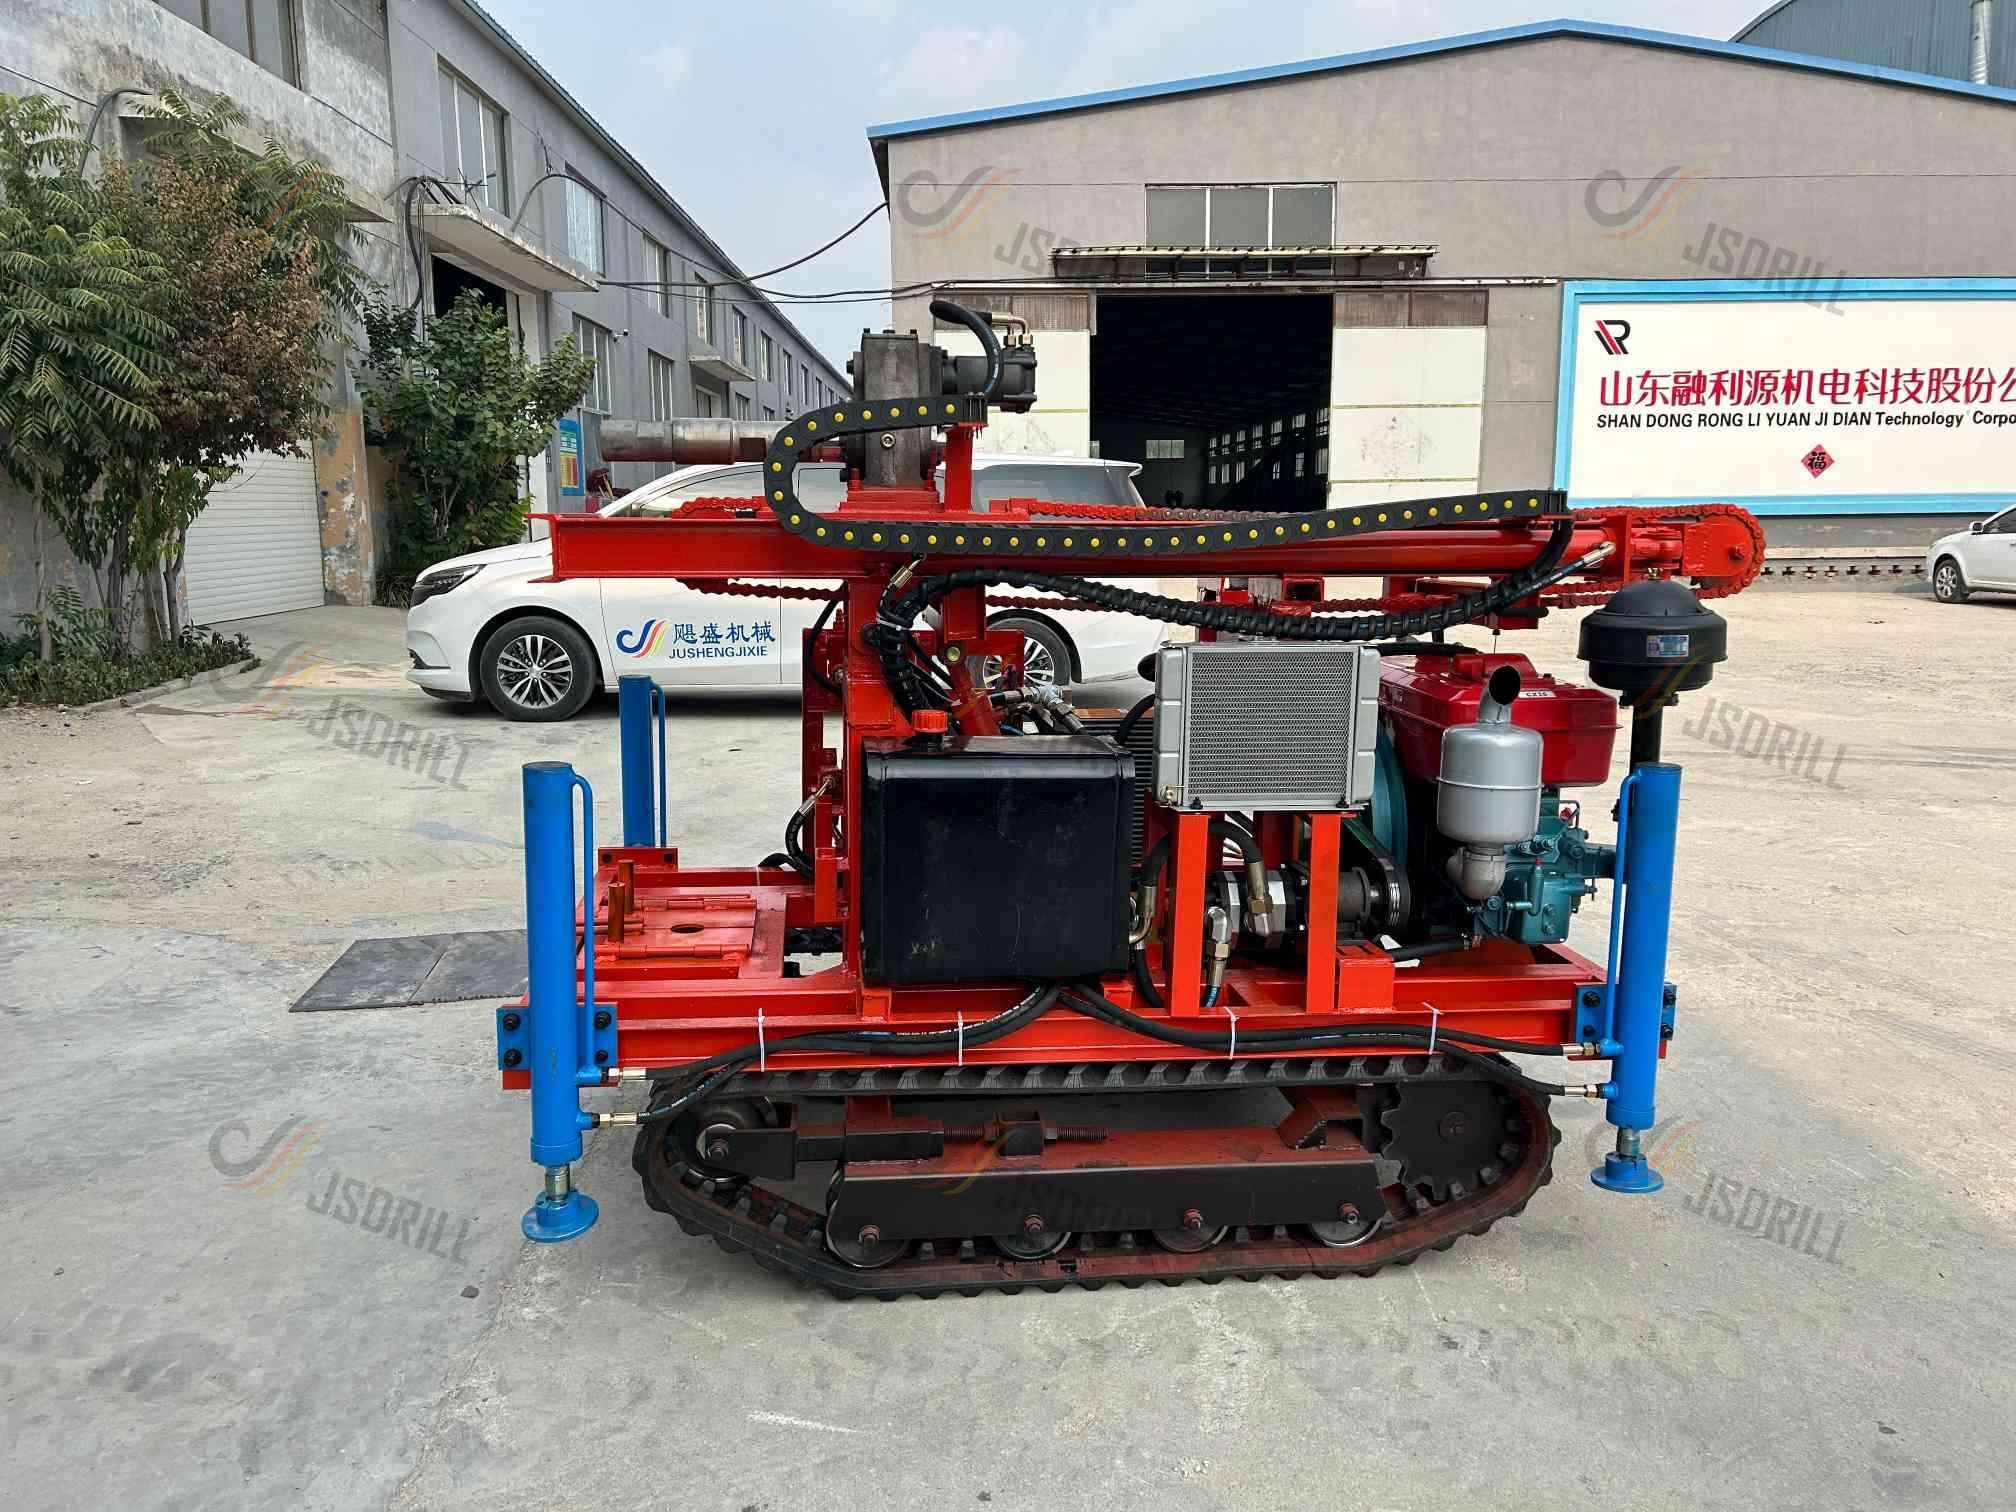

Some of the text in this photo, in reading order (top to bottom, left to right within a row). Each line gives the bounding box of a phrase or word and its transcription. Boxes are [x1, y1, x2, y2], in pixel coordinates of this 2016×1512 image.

[1597, 414, 1642, 428] SHAN
[1646, 413, 1693, 428] DONG
[1698, 413, 1743, 427] RONG
[1748, 413, 1760, 426] LI
[1766, 412, 1811, 426] YUAN
[1815, 412, 1828, 426] JI
[1833, 412, 1872, 426] DIAN
[1875, 411, 1964, 428] Technology
[1807, 451, 1826, 470] 福
[669, 646, 768, 659] JUSHENGJIXIE
